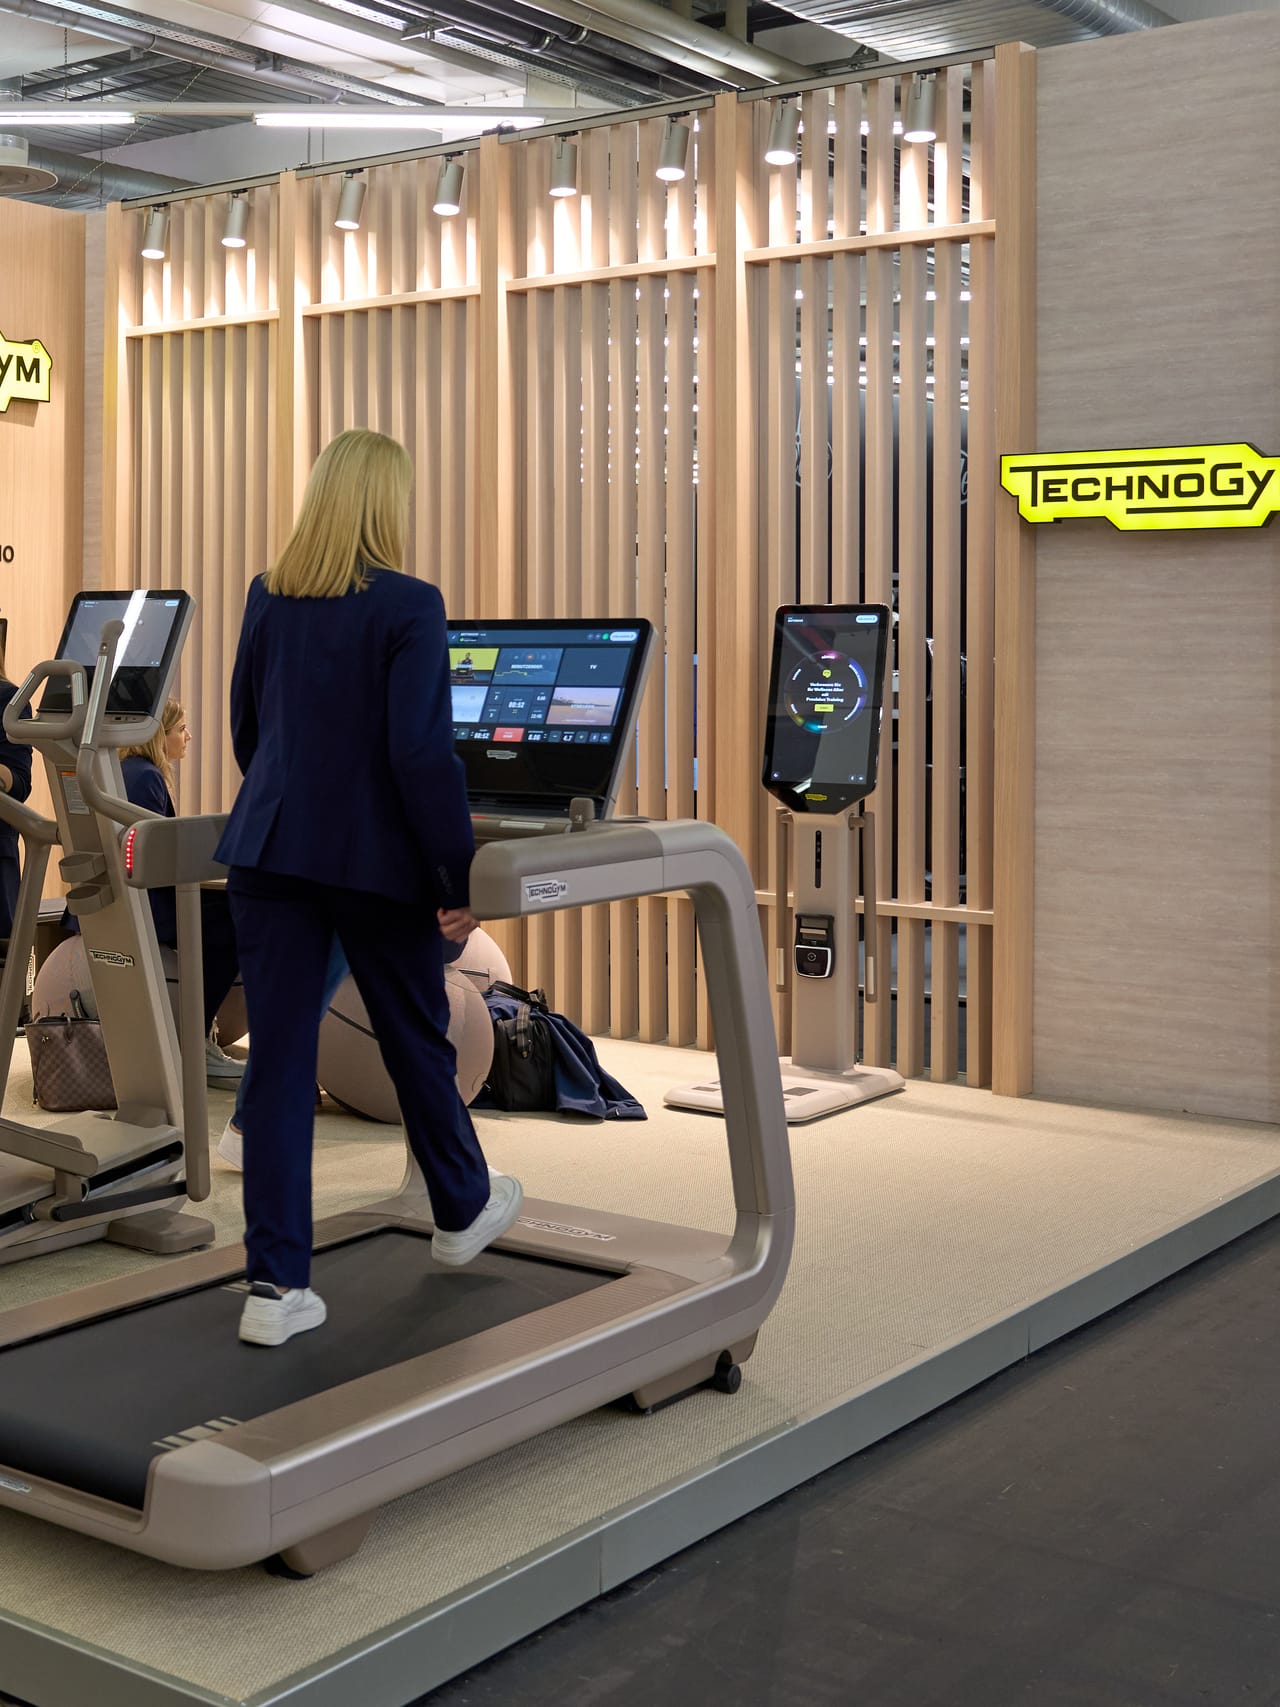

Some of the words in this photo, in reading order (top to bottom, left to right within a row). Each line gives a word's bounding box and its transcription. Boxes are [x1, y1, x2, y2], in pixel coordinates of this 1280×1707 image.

[1009, 457, 1276, 514] TECHNOGY
[525, 882, 566, 899] TECHNOGYM
[517, 1217, 610, 1240] CHNOGYM
